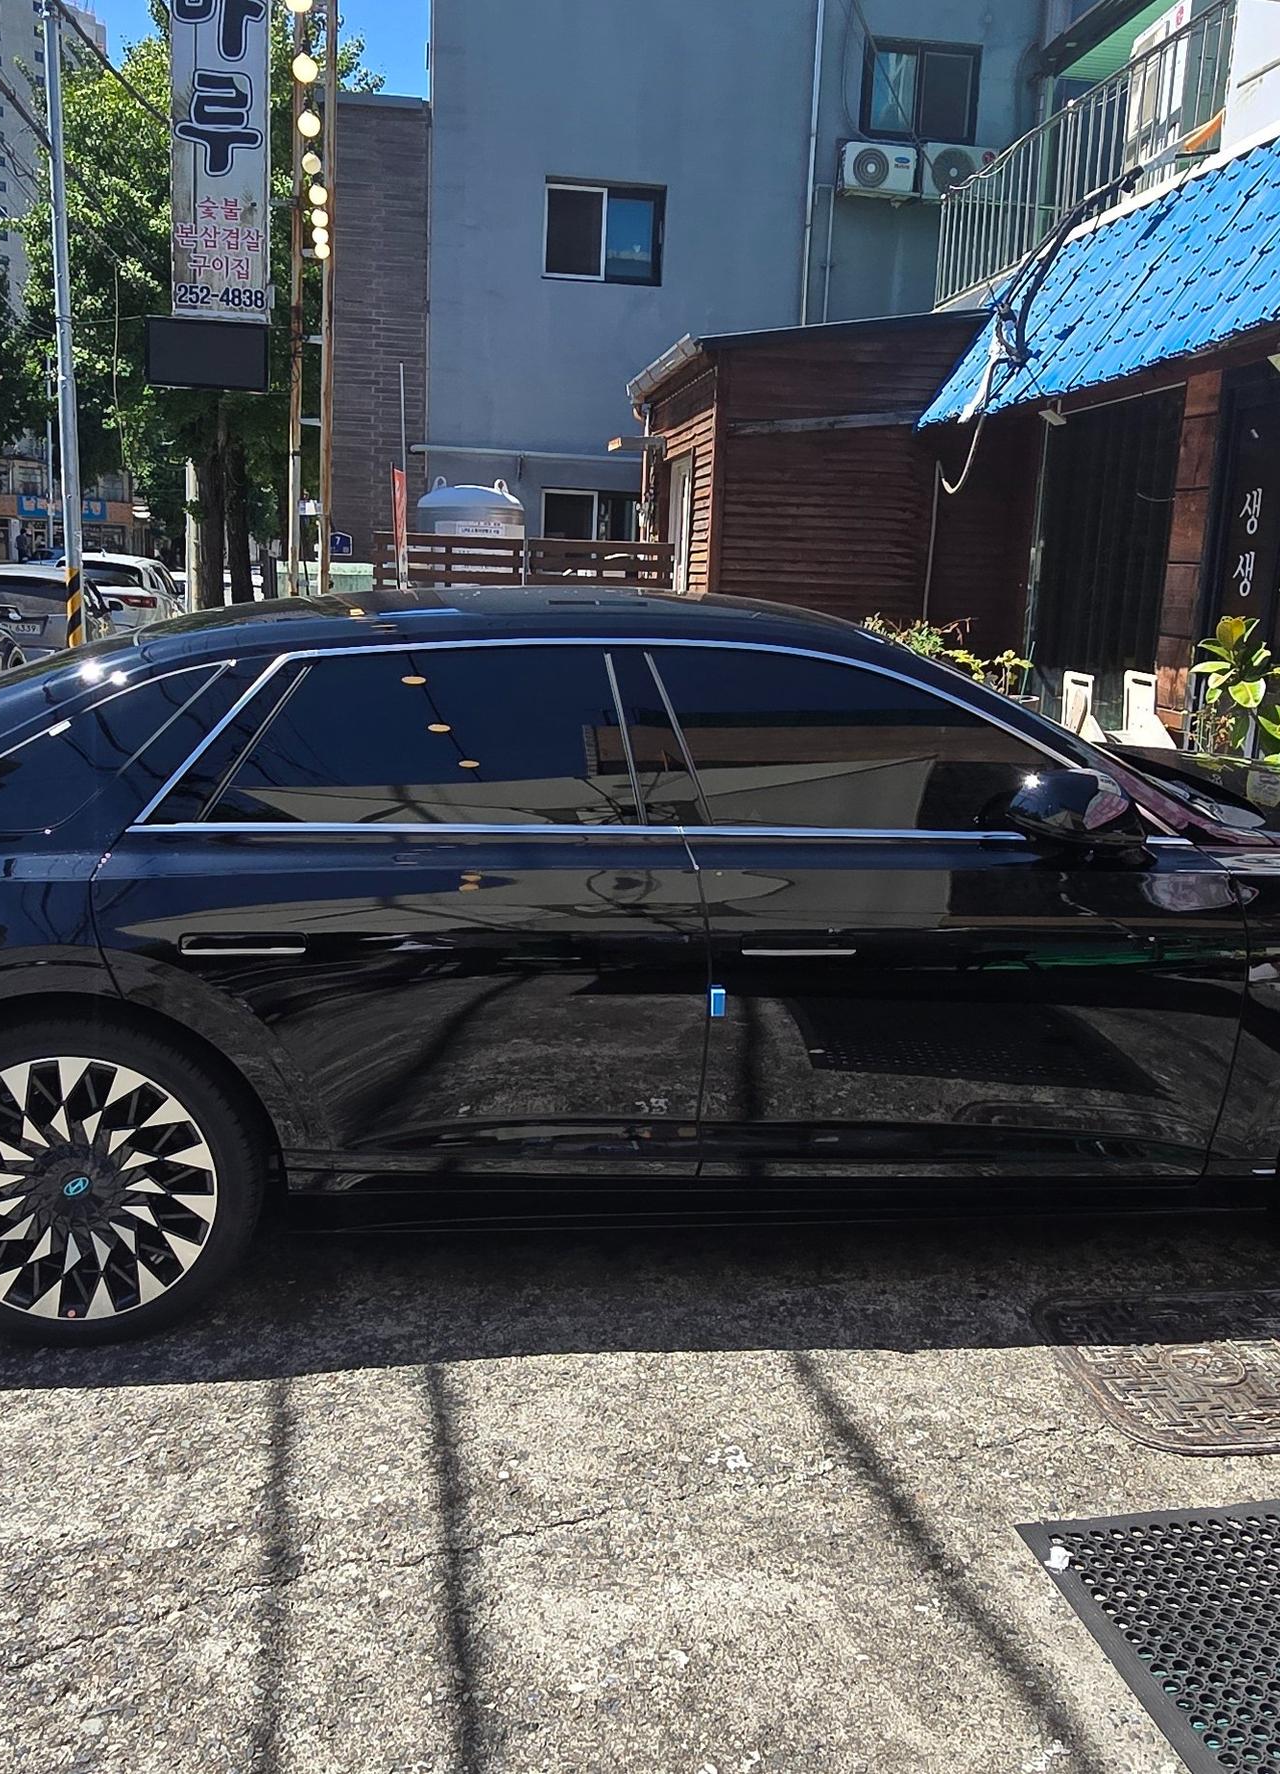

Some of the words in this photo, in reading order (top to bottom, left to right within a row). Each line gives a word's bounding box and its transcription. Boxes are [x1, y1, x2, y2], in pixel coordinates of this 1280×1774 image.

[197, 196, 242, 221] 숯불
[176, 224, 264, 252] 본삼겹살
[189, 255, 250, 280] 구이집
[177, 285, 265, 308] 252-4838
